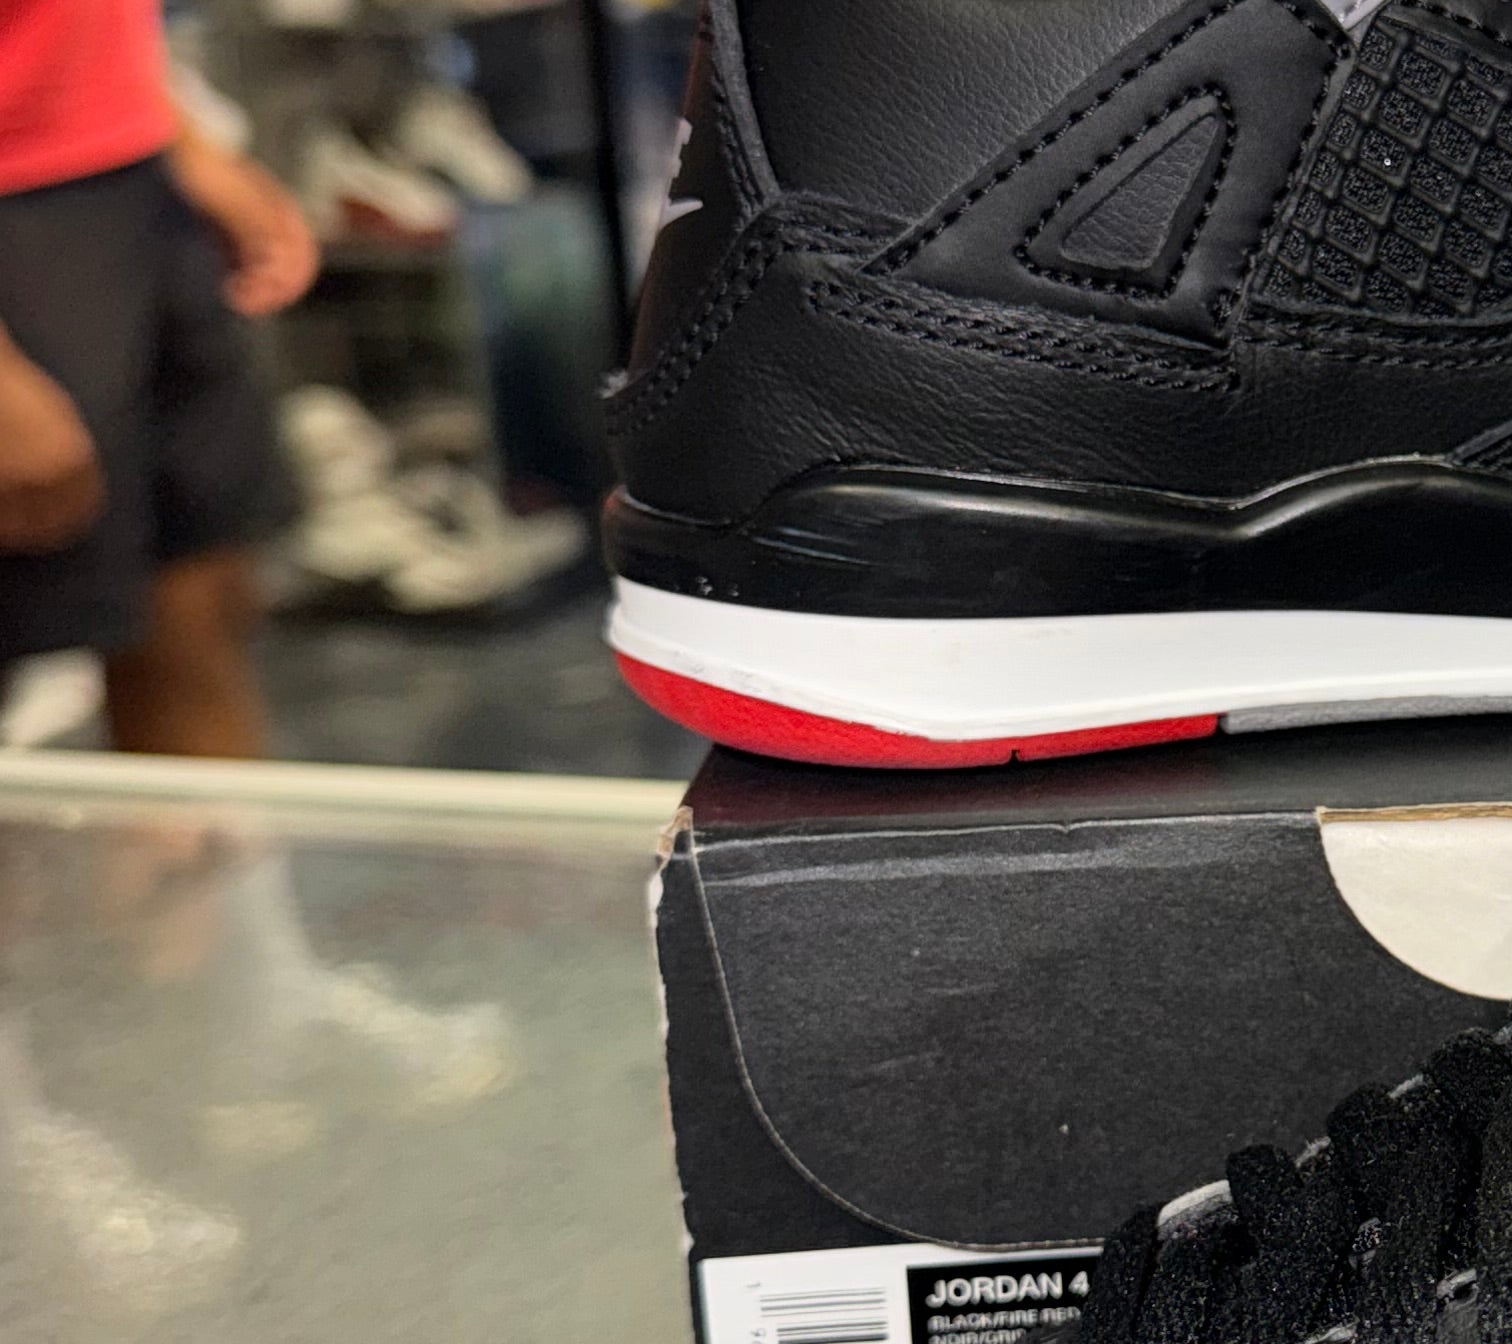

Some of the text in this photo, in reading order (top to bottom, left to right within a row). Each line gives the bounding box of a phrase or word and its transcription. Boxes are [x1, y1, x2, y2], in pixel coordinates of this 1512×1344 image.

[926, 1270, 1090, 1308] JORDAN 4
[928, 1309, 1039, 1333] BLACK/FIRE
